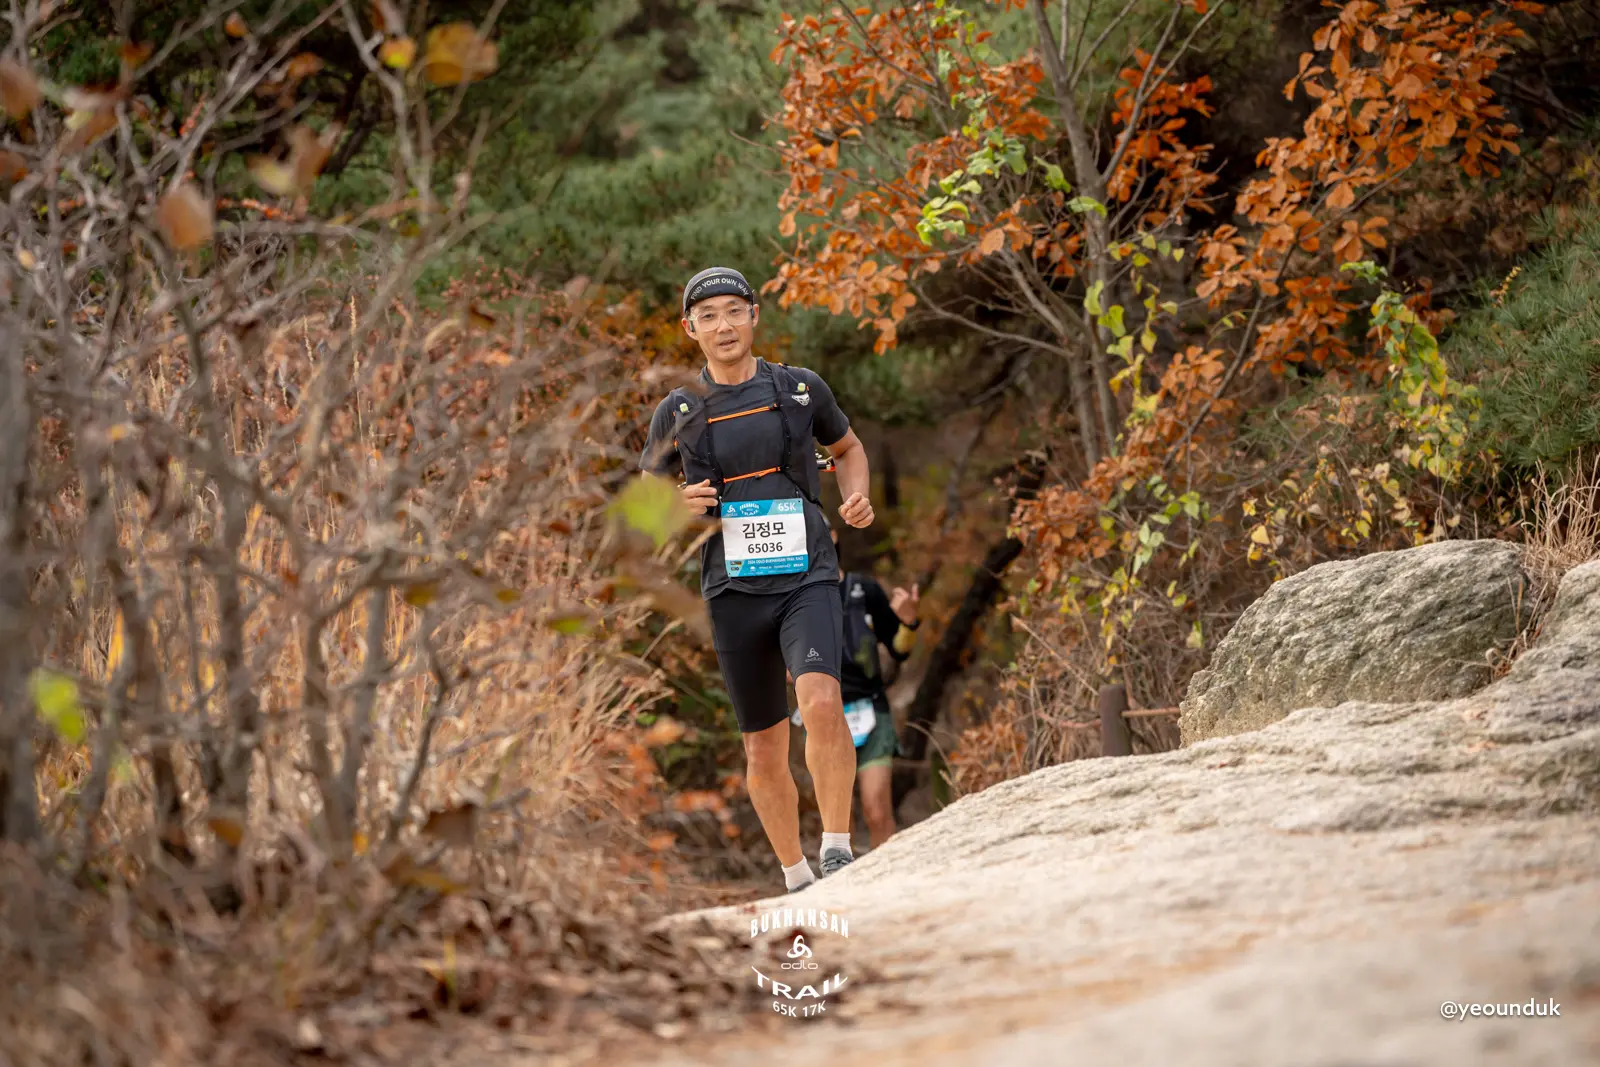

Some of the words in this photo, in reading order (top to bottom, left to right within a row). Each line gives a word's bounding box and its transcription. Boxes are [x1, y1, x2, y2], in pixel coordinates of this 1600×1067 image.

[691, 286, 702, 300] FIND
[702, 278, 720, 287] YOUR
[721, 277, 737, 286] OWN
[738, 282, 749, 296] WAY
[777, 502, 796, 512] 65K
[742, 522, 786, 538] 김정모
[748, 542, 783, 553] 65036
